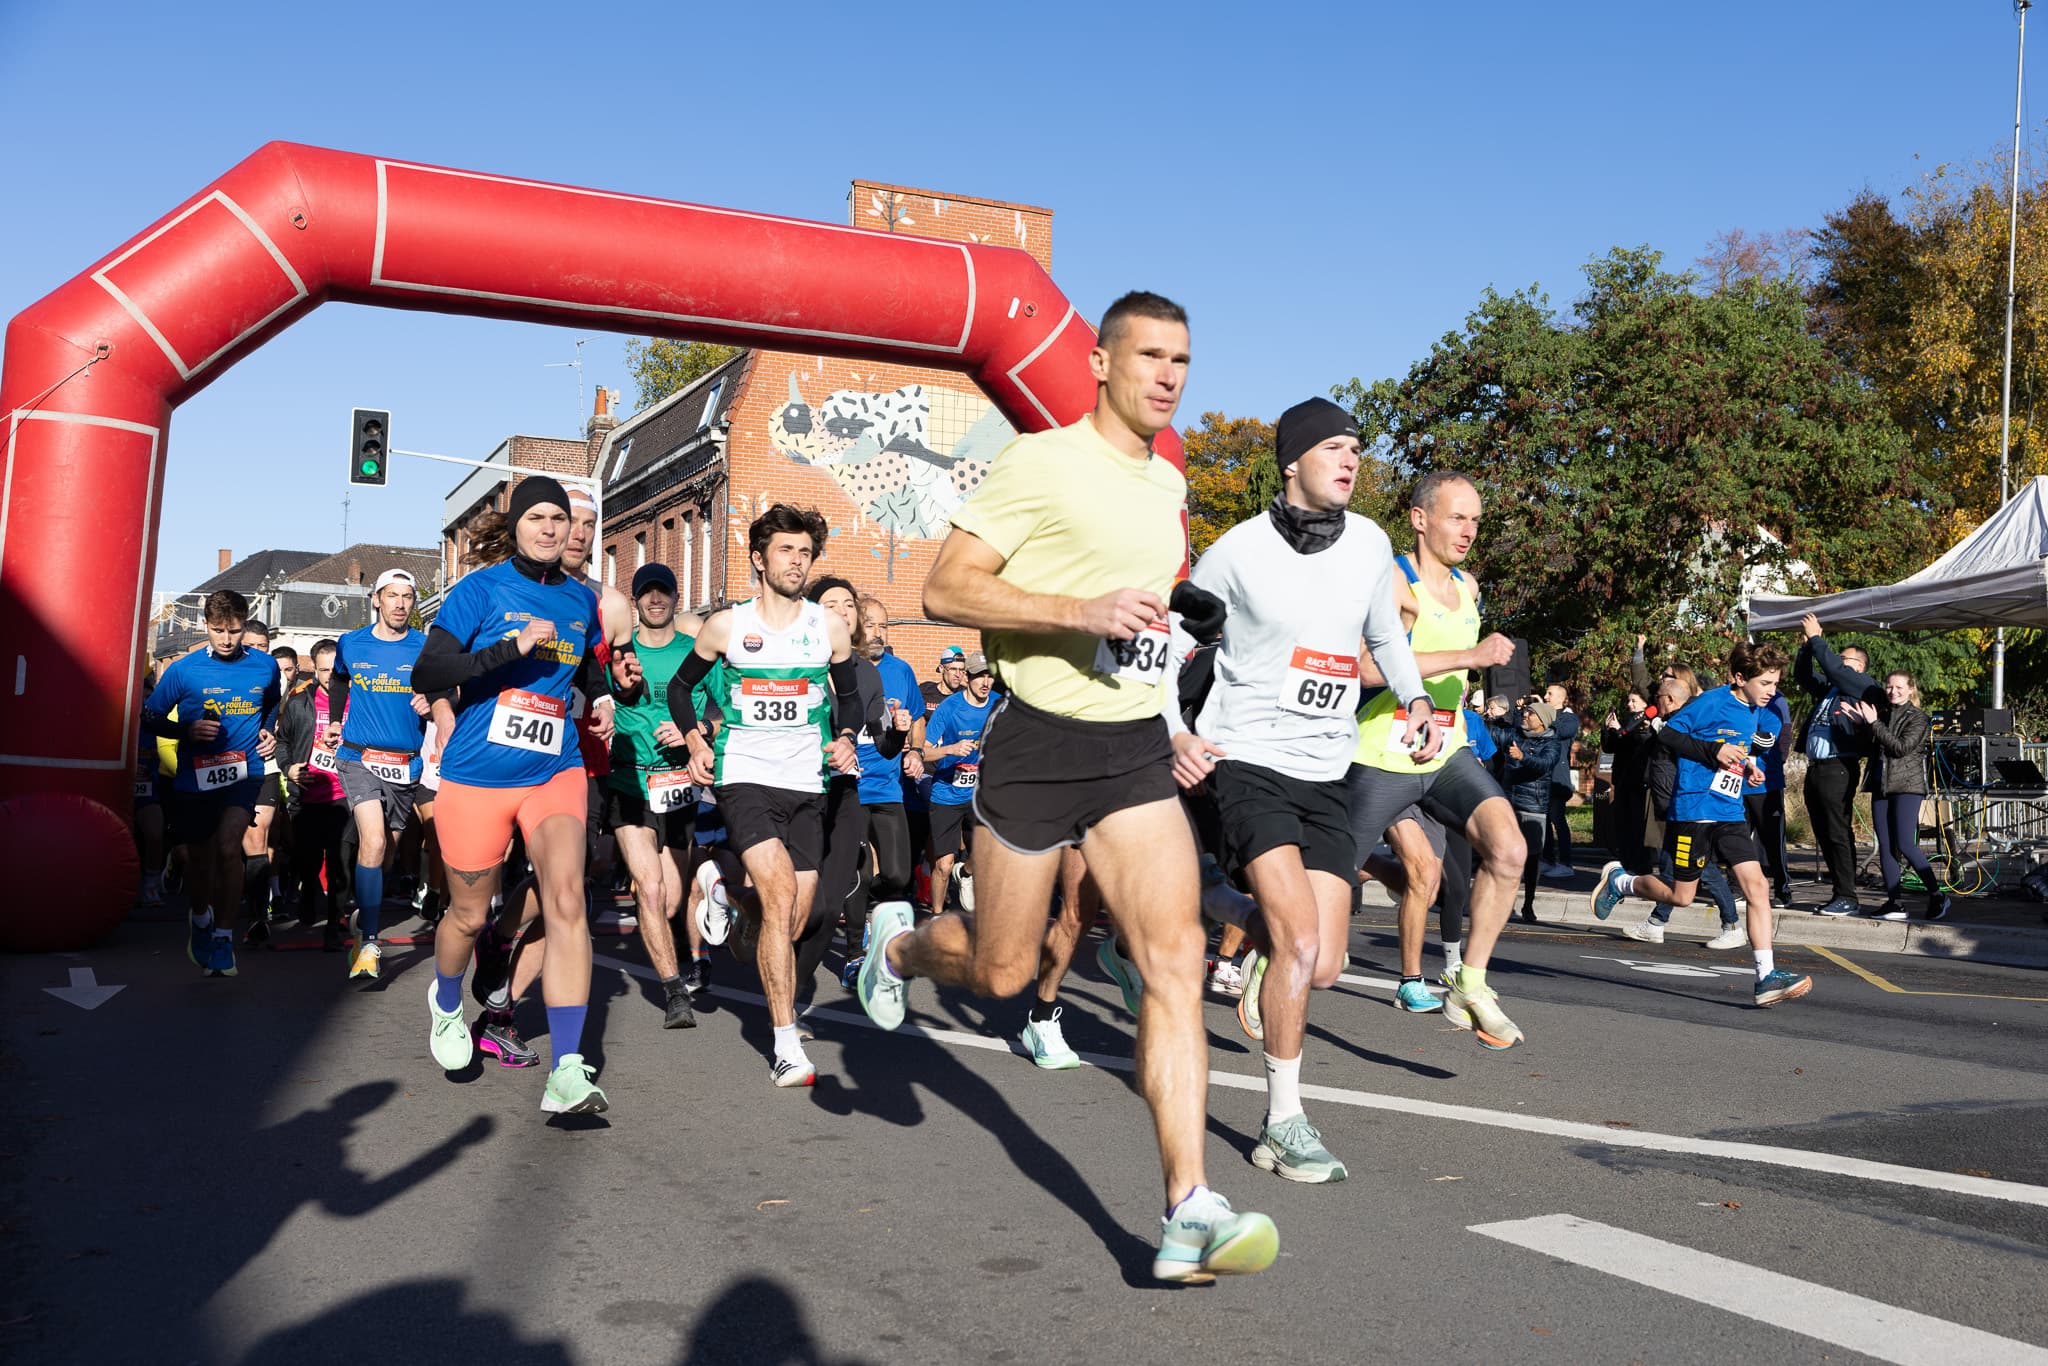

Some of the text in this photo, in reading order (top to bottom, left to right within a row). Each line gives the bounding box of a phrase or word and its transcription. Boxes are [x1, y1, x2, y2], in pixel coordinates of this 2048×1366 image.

[1305, 656, 1327, 668] RACE
[1333, 662, 1353, 672] RESULT
[773, 684, 800, 692] RESULT
[1298, 679, 1347, 710] 697
[511, 694, 531, 706] RACE
[535, 700, 559, 712] RESULT
[753, 700, 798, 721] 338
[505, 714, 554, 746] 540
[207, 766, 238, 784] 483
[371, 765, 402, 780] 508
[1720, 774, 1740, 794] 516
[660, 786, 694, 807] 498
